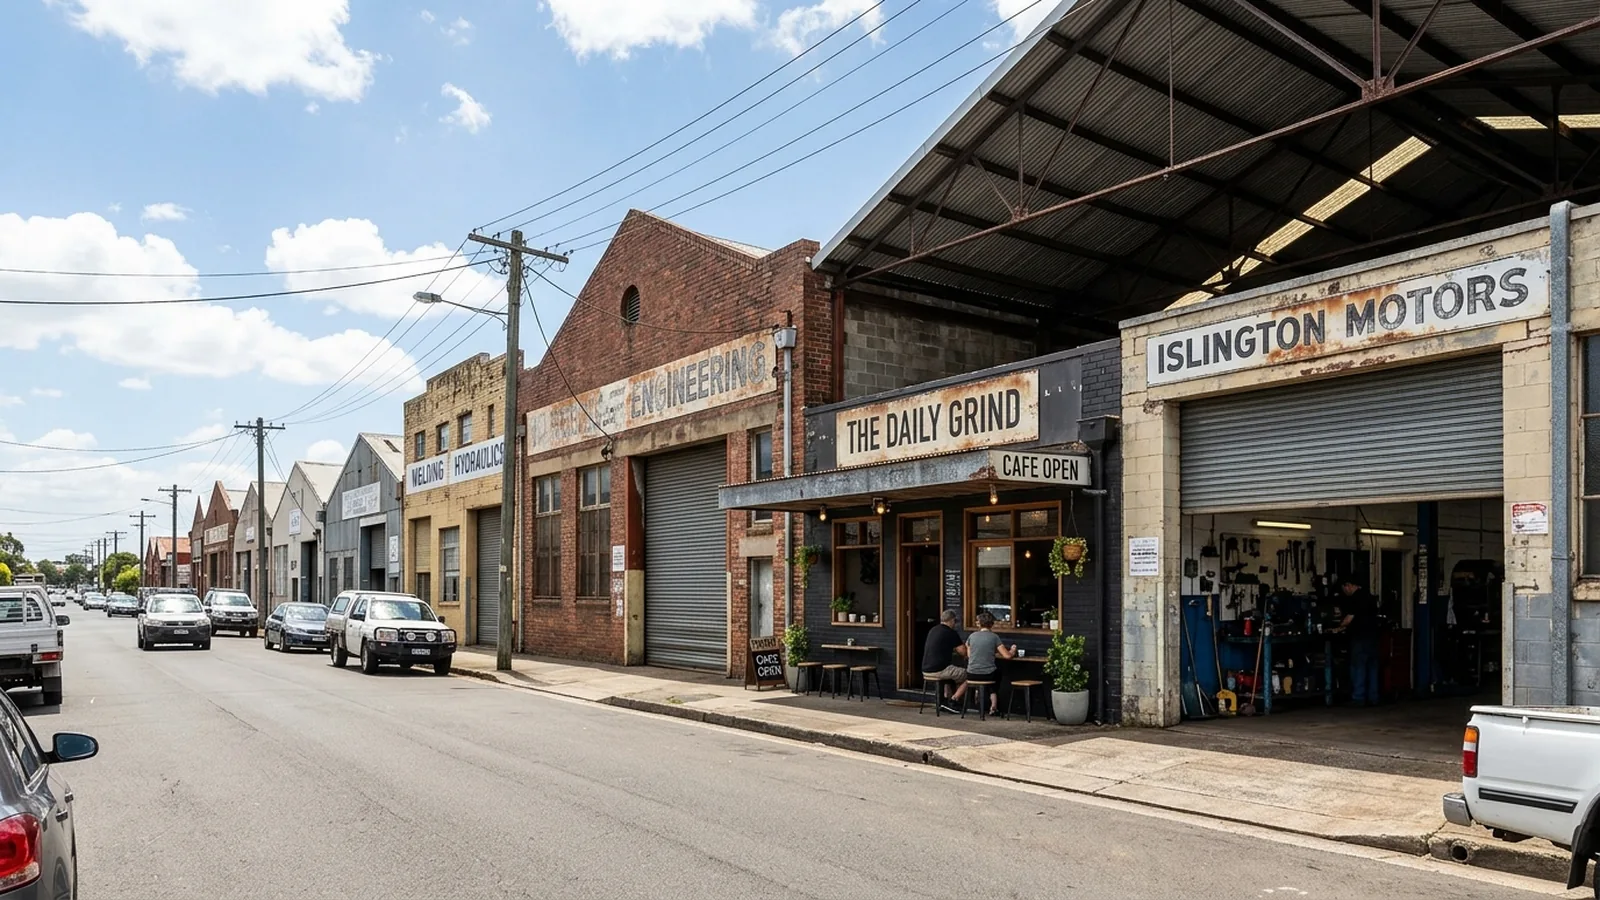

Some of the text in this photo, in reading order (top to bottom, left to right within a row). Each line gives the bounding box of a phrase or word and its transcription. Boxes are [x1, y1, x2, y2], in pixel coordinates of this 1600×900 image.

[1158, 267, 1529, 374] ISLINGTON MOTORS
[630, 340, 766, 419] ENGINEERING
[847, 388, 1021, 454] THE DAILY GRIND
[1002, 454, 1079, 481] CAFE OPEN
